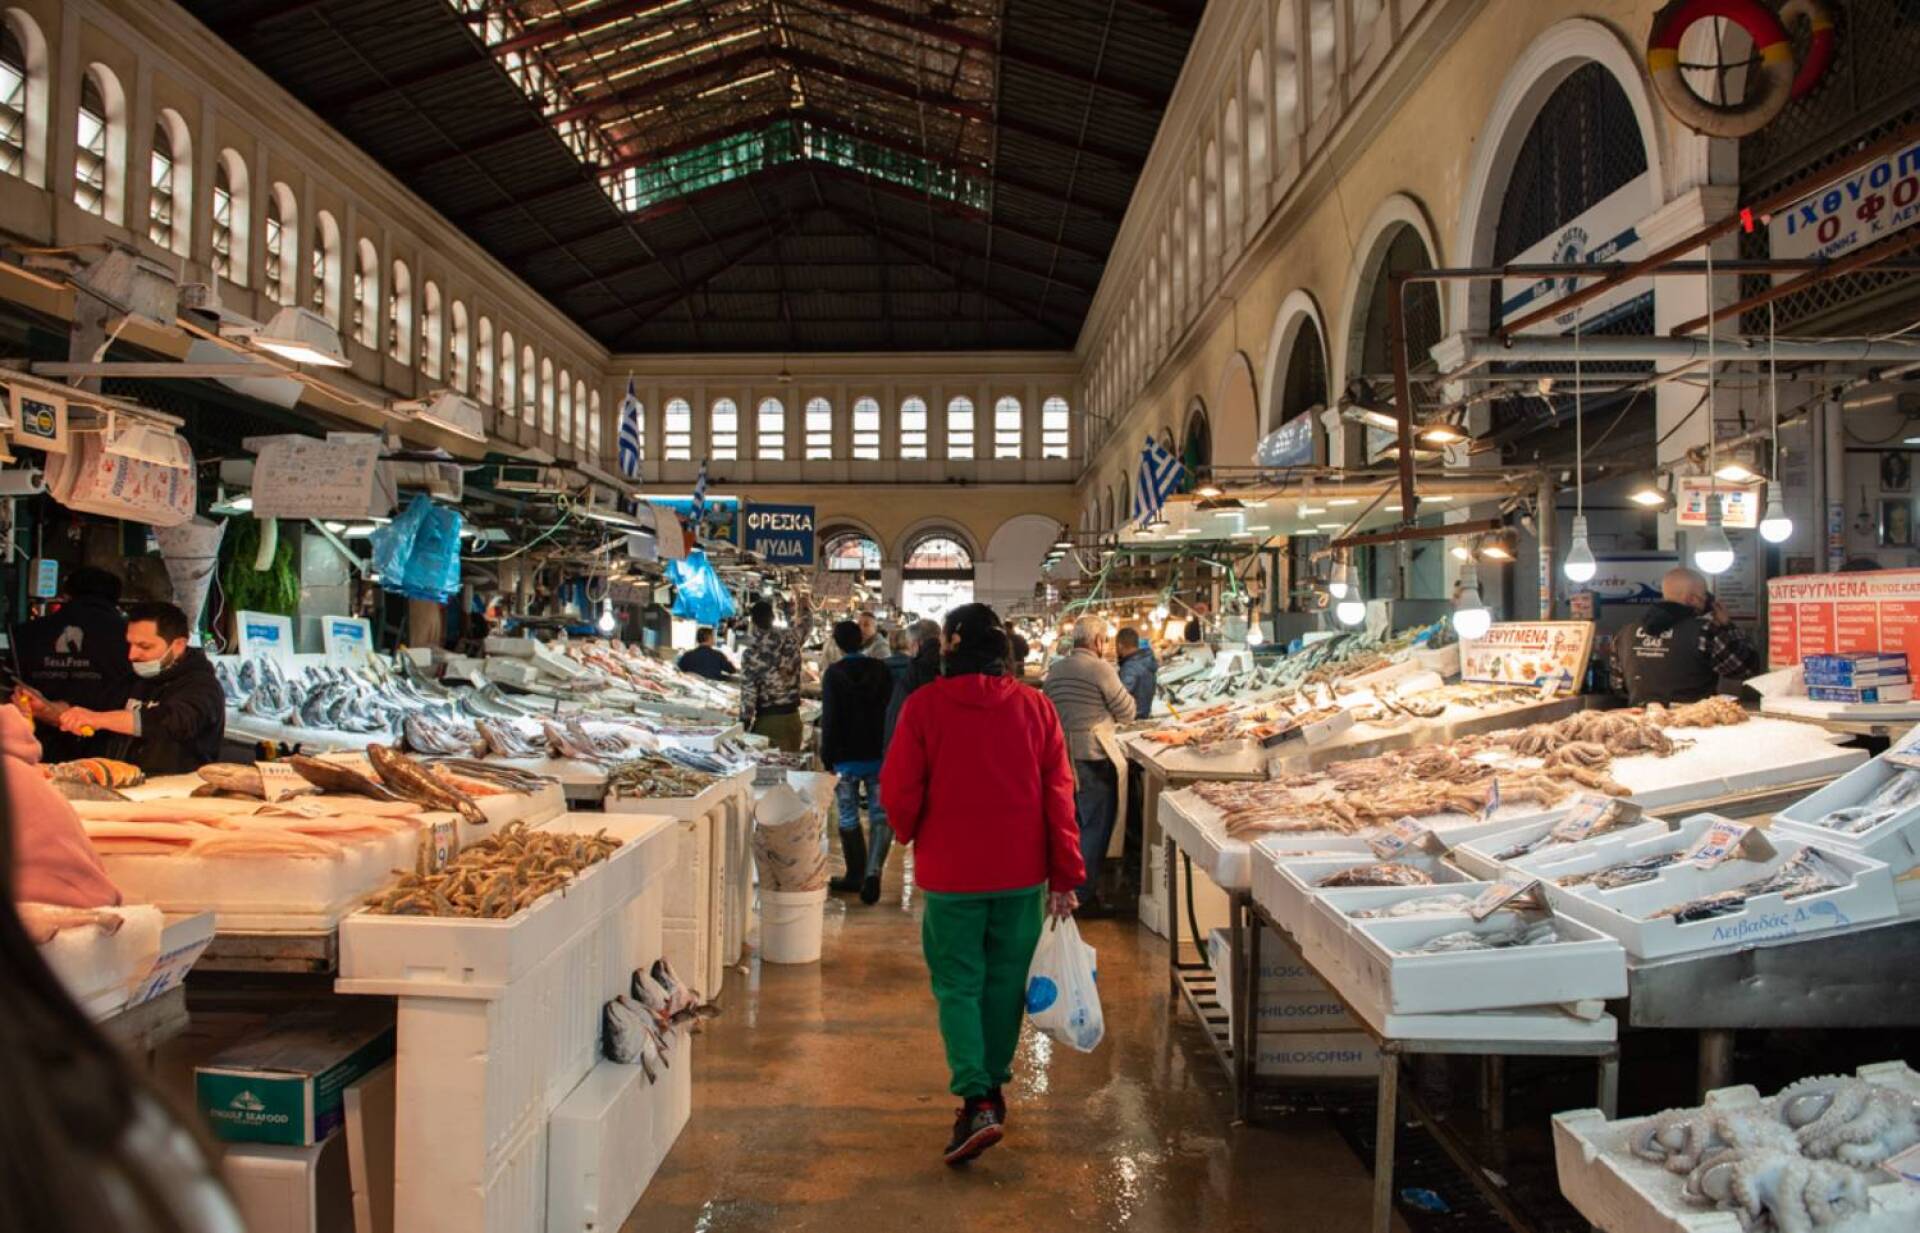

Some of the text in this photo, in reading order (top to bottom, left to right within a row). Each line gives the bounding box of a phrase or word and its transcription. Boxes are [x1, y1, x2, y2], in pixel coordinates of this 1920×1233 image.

[748, 512, 813, 531] ΦΡΕΣΚΑ
[756, 538, 804, 558] ΜΥΔΙΑ
[1768, 582, 1868, 599] ΚΑΤΕΨΥΓΜΕΝΑ
[1712, 912, 1789, 942] Λειβαδάς
[1260, 1050, 1362, 1064] PHILOSOFISH
[246, 1111, 289, 1124] SEAFOOD
